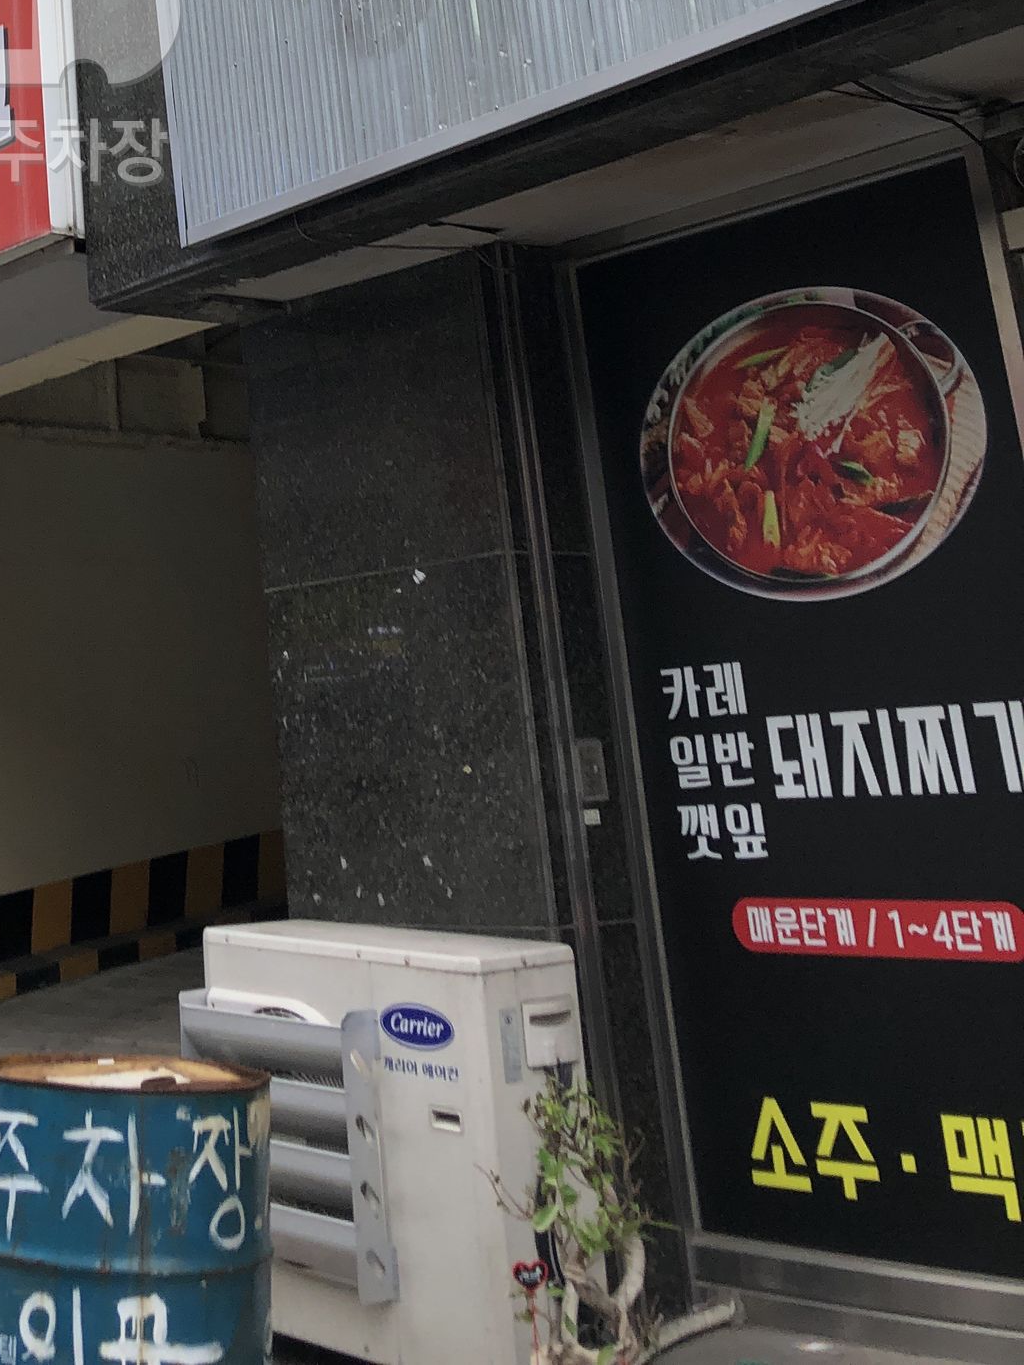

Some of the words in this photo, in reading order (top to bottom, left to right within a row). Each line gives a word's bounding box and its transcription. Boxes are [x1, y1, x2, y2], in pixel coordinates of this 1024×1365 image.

[660, 661, 748, 720] 카레
[669, 731, 755, 789] 일반
[677, 802, 769, 860] 깻잎
[746, 905, 857, 947] 매운단계
[887, 909, 1017, 952] 1~4단계
[390, 1011, 445, 1039] Carrier
[751, 1096, 881, 1201] 소주
[940, 1114, 1024, 1222] 맥
